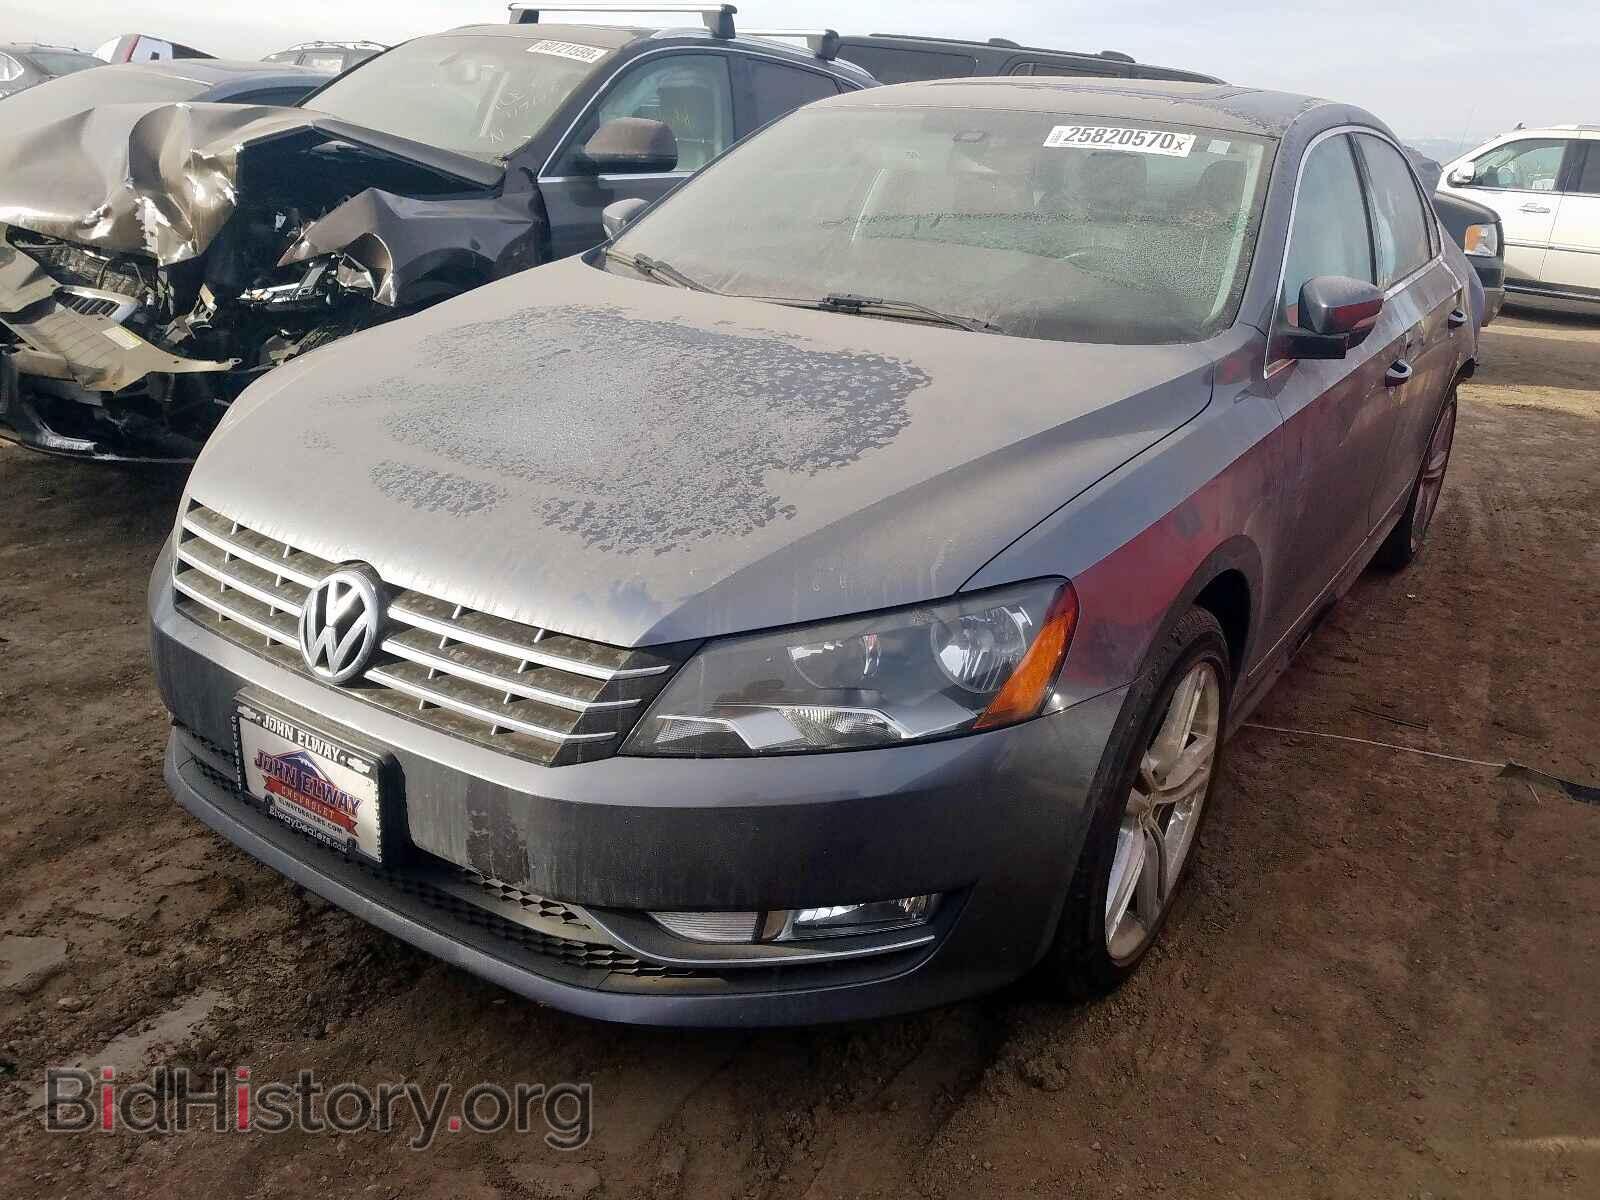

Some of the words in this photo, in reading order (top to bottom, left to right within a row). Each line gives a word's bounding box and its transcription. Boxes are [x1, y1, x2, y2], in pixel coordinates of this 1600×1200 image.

[262, 713, 294, 741] JOHN
[297, 731, 341, 763] ELWAY
[254, 750, 299, 787] JOHN
[300, 771, 363, 817] ELWAY
[281, 786, 335, 818] CHEVROLET
